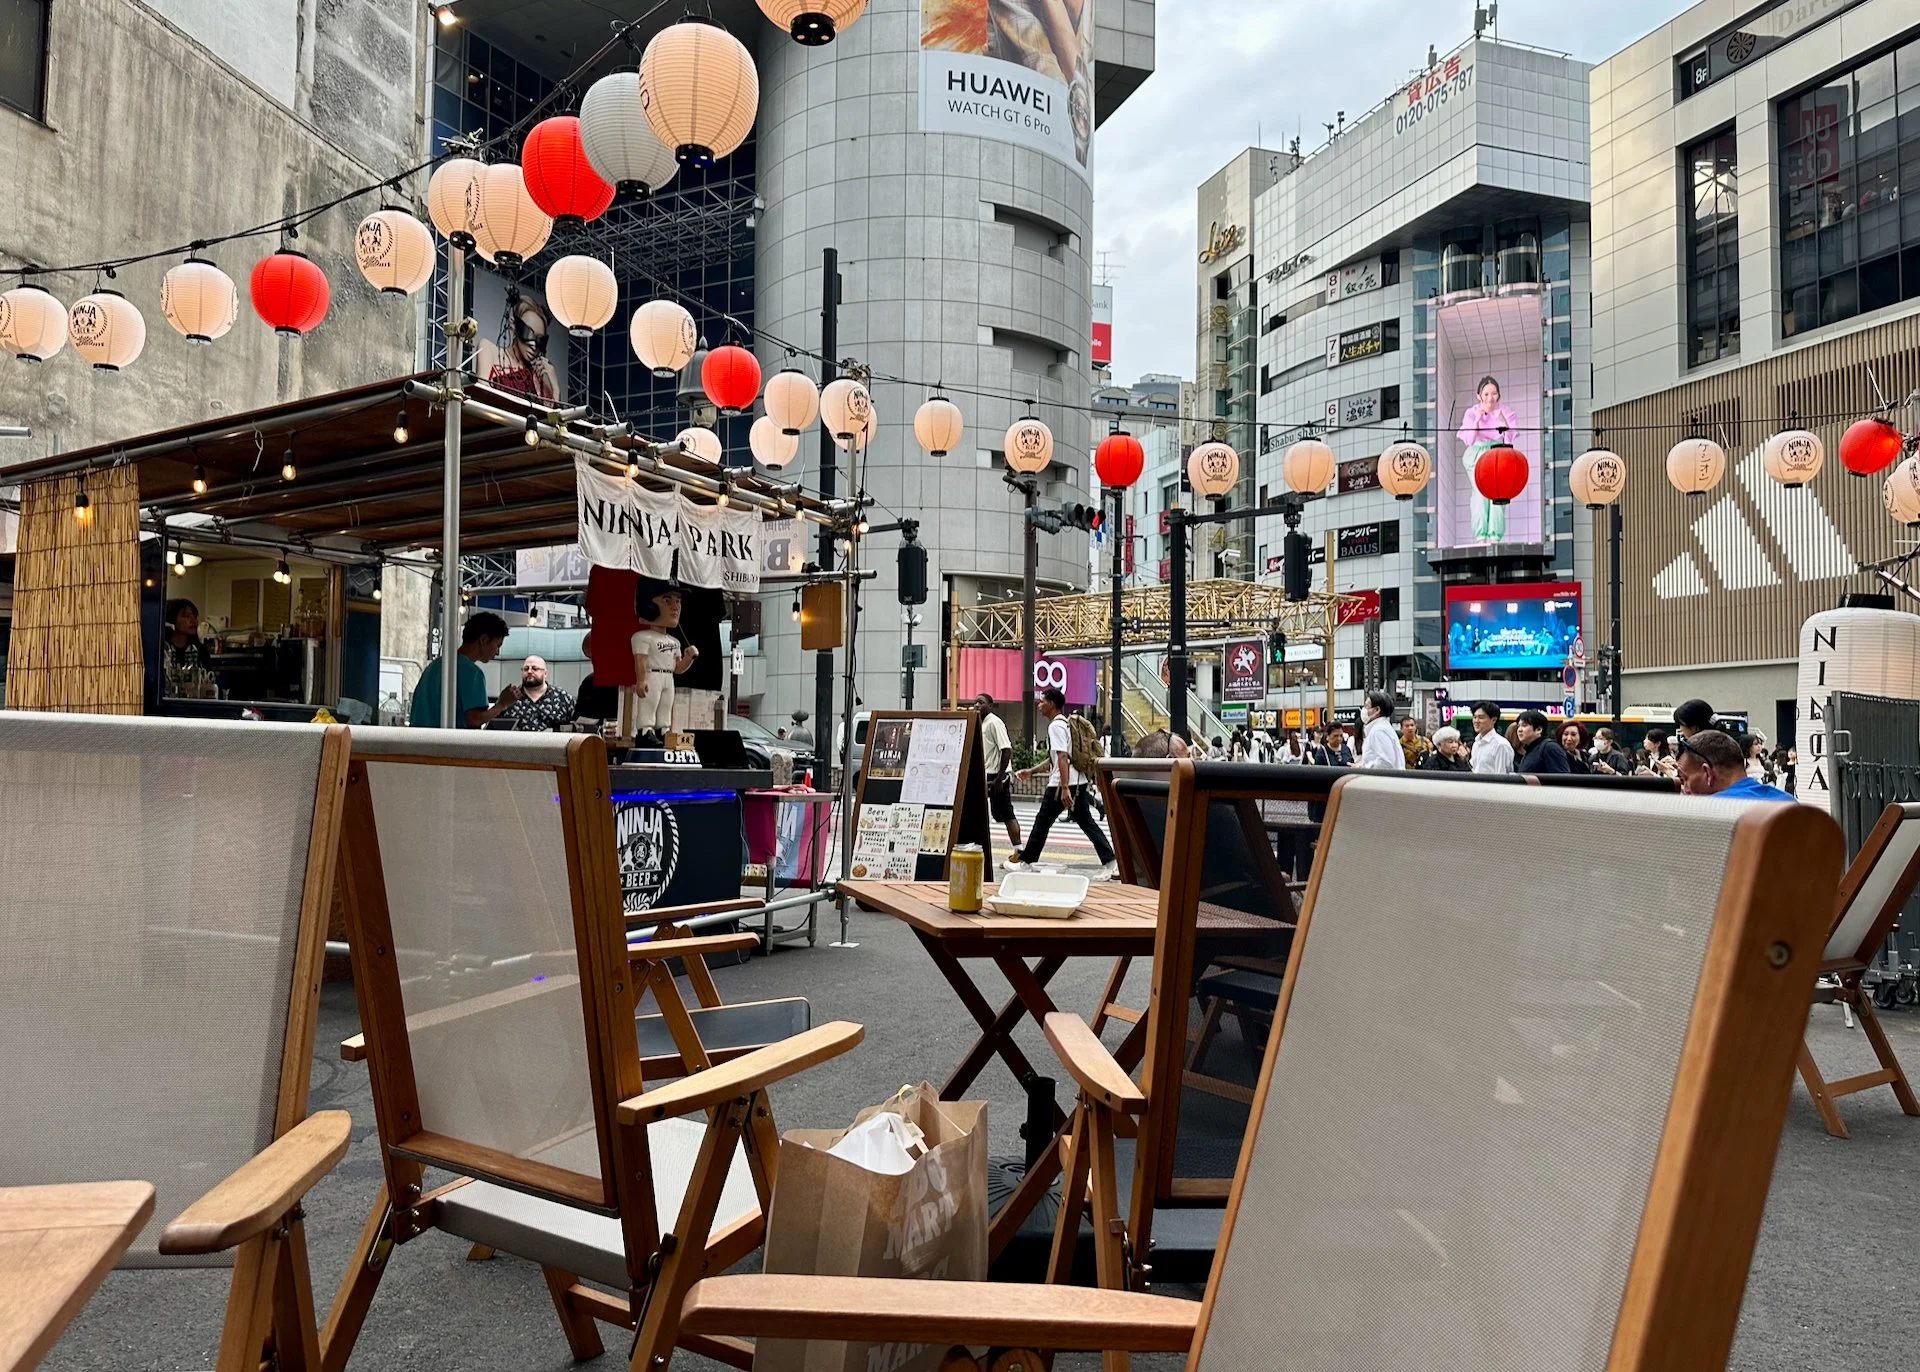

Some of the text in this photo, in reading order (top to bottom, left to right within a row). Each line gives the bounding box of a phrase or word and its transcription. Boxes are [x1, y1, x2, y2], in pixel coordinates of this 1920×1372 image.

[1407, 55, 1462, 107] 貸広告
[1695, 67, 1708, 85] 8F
[947, 70, 1051, 115] HUAWEI
[1396, 64, 1474, 135] 0120-075-787
[947, 99, 1051, 136] WATCH GT 6 Pro
[358, 222, 383, 237] NINJA
[73, 304, 98, 319] NINJA
[1270, 433, 1294, 450] Shabu
[1788, 440, 1812, 452] NINJA
[1207, 451, 1227, 463] NINJA
[1399, 451, 1420, 462] NINJA
[1597, 461, 1618, 473] NINJA
[583, 495, 754, 561] NINJA PARK
[1340, 525, 1378, 540] ダーツバー
[1340, 542, 1378, 556] BAGUS
[1565, 702, 1574, 715] P
[879, 749, 901, 760] NINJA
[867, 807, 885, 816] Beer
[617, 806, 663, 849] NINJA
[626, 872, 651, 888] BEER
[882, 1191, 955, 1260] MART
